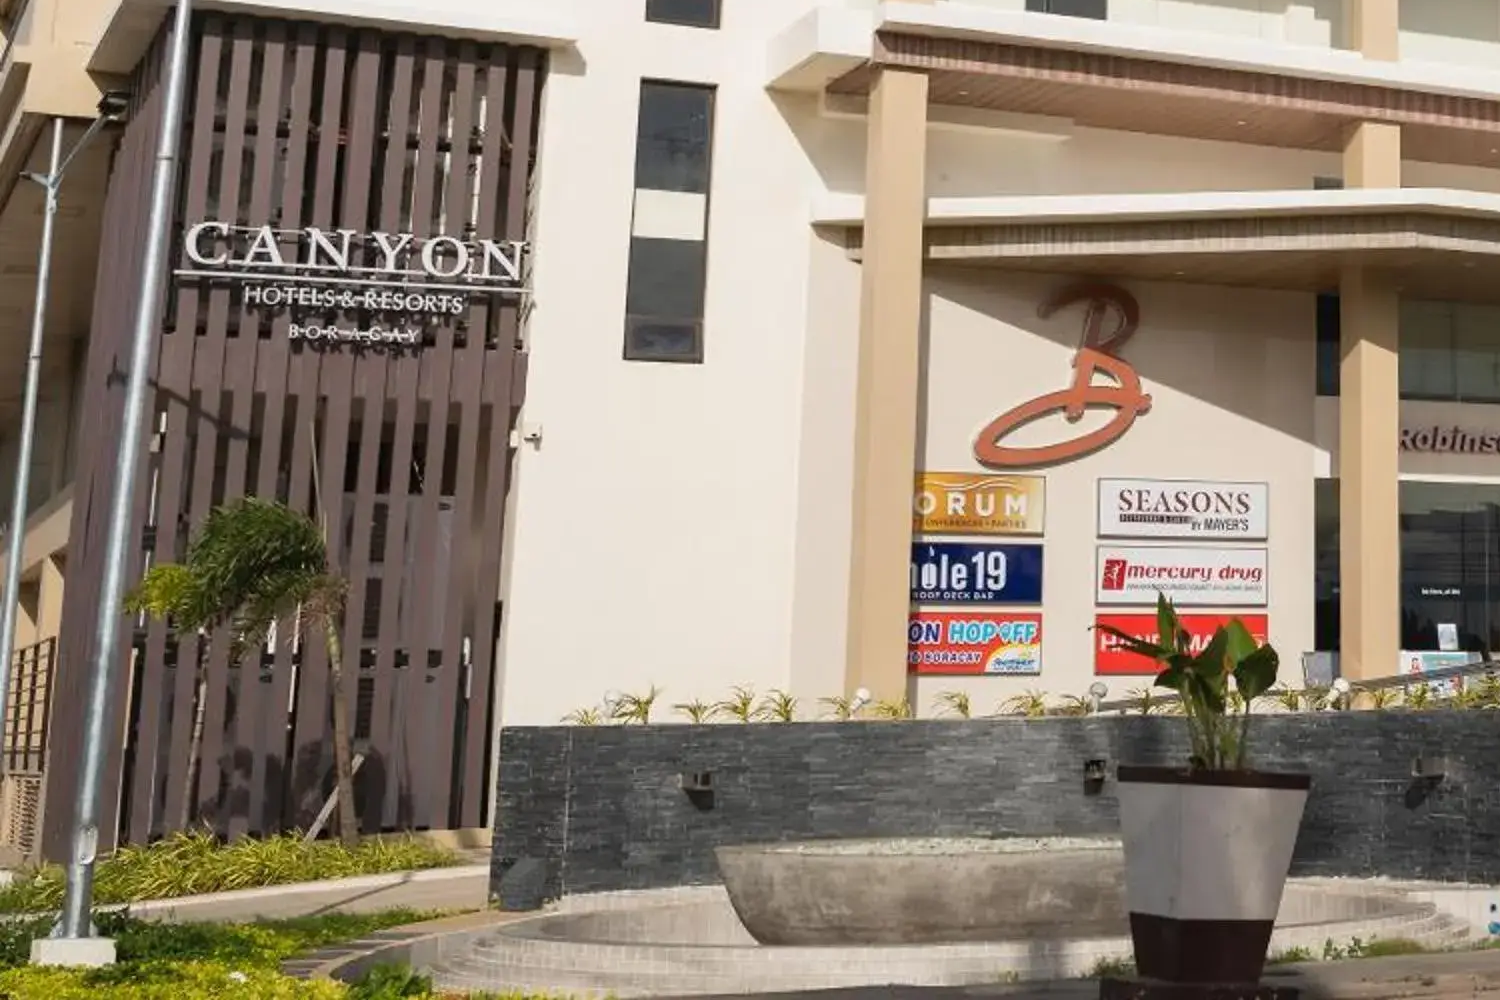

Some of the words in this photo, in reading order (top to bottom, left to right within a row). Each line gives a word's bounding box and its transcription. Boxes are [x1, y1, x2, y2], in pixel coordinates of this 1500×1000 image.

[184, 222, 528, 281] CANYON
[244, 286, 336, 308] HOTELS
[341, 292, 359, 308] &
[364, 292, 464, 314] RESORTS
[288, 324, 420, 343] BORACAY
[974, 284, 1152, 470] B
[1118, 488, 1252, 515] SEASONS
[971, 551, 1007, 591] 19
[1127, 565, 1213, 582] mercury
[1218, 565, 1262, 582] drug
[948, 621, 996, 644] HOP
